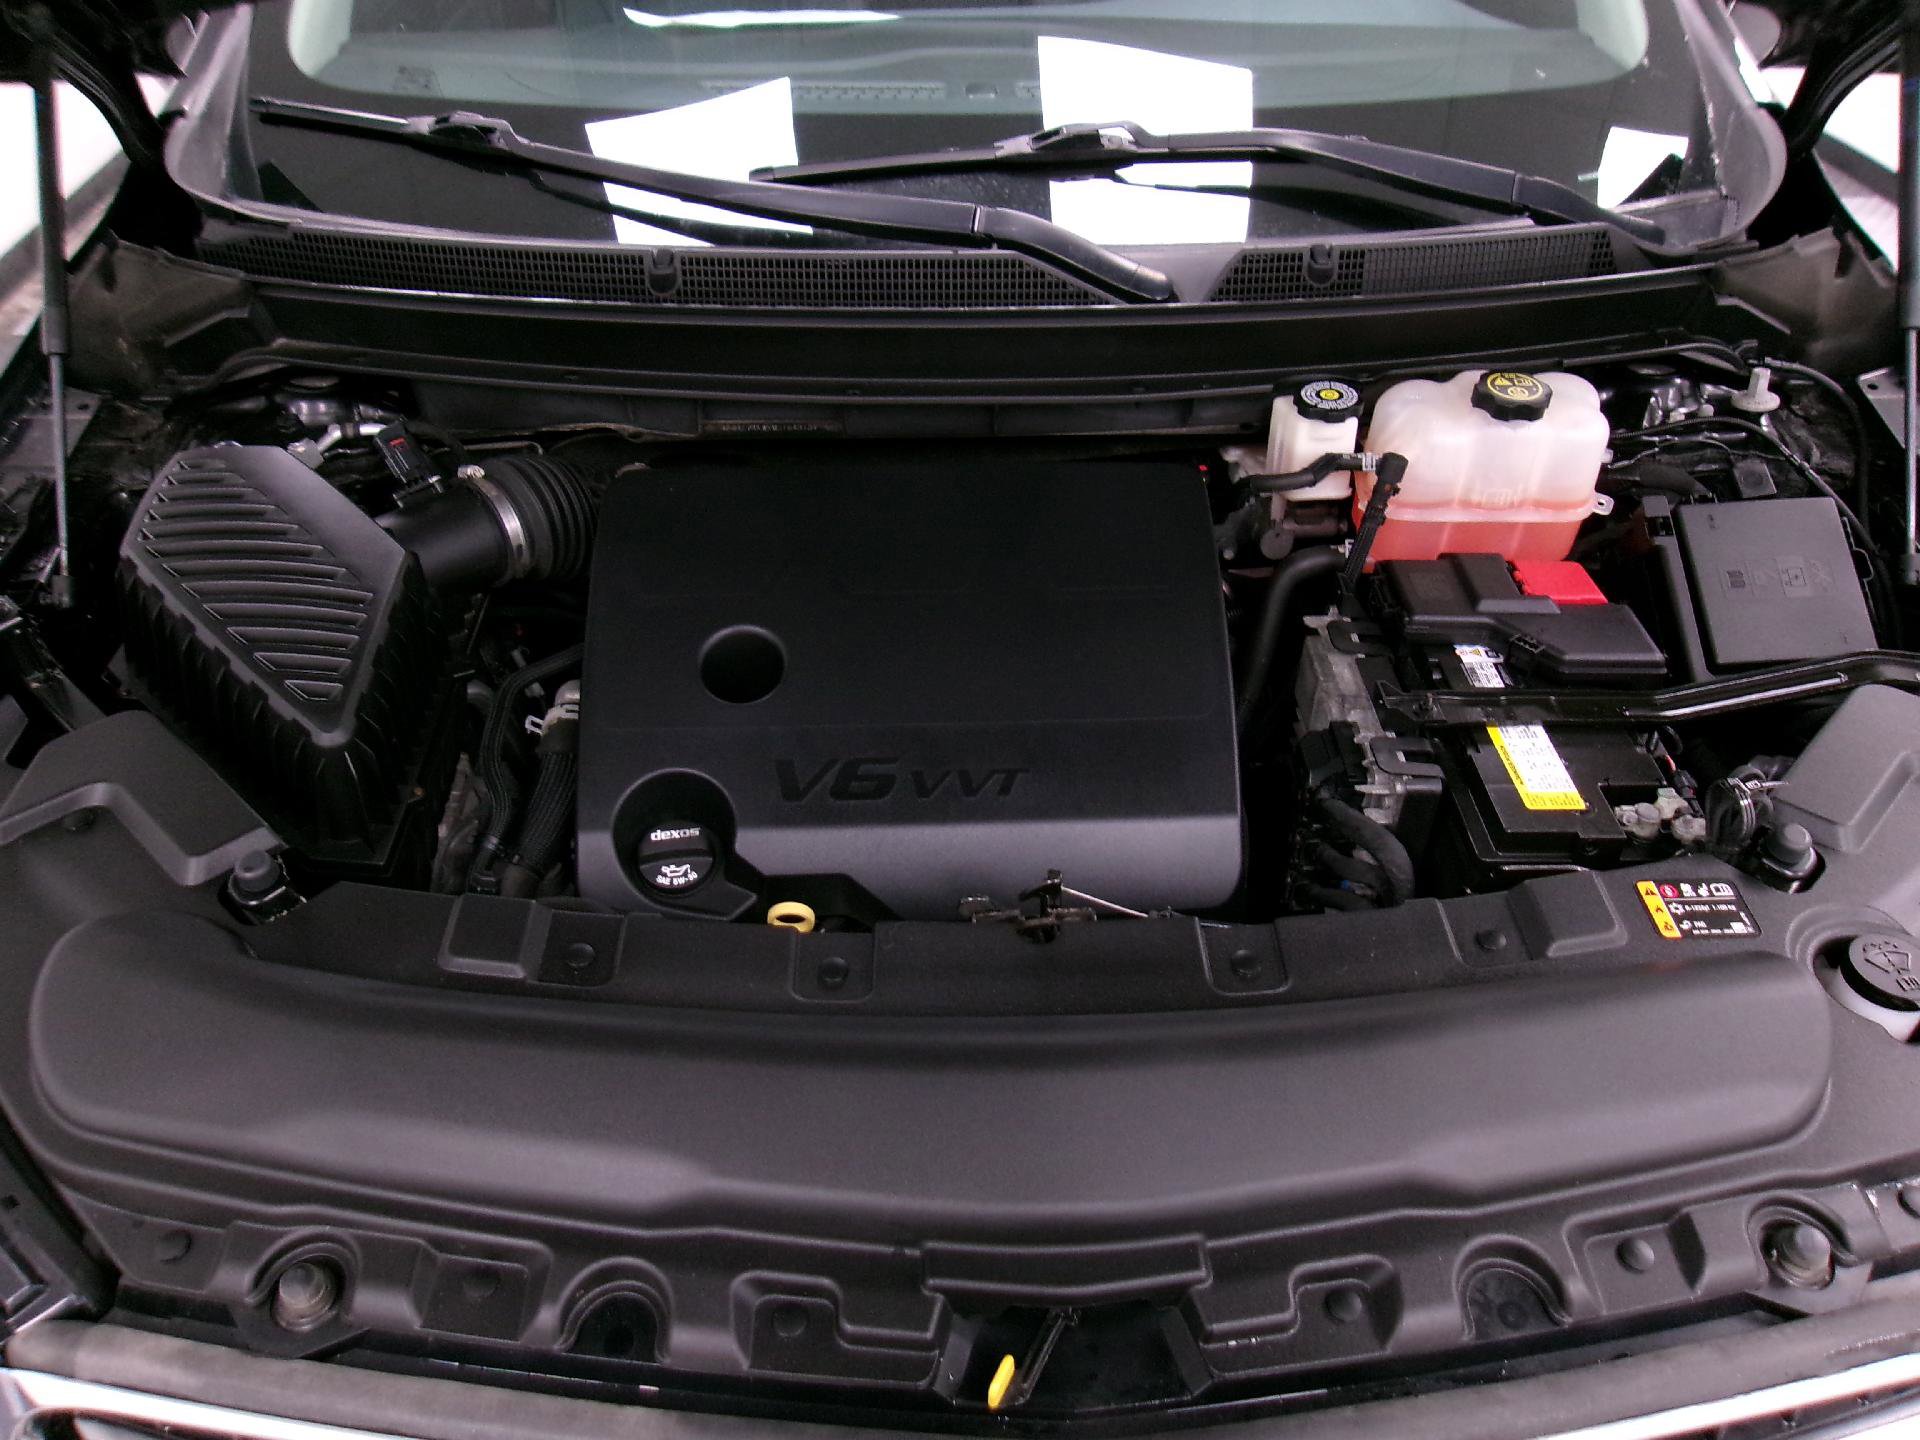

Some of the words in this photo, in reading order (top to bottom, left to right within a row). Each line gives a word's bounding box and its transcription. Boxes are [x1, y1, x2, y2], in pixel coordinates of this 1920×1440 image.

[774, 757, 900, 801] V6
[911, 768, 1030, 800] VVT
[650, 827, 701, 841] dexos
[656, 874, 671, 885] SAE
